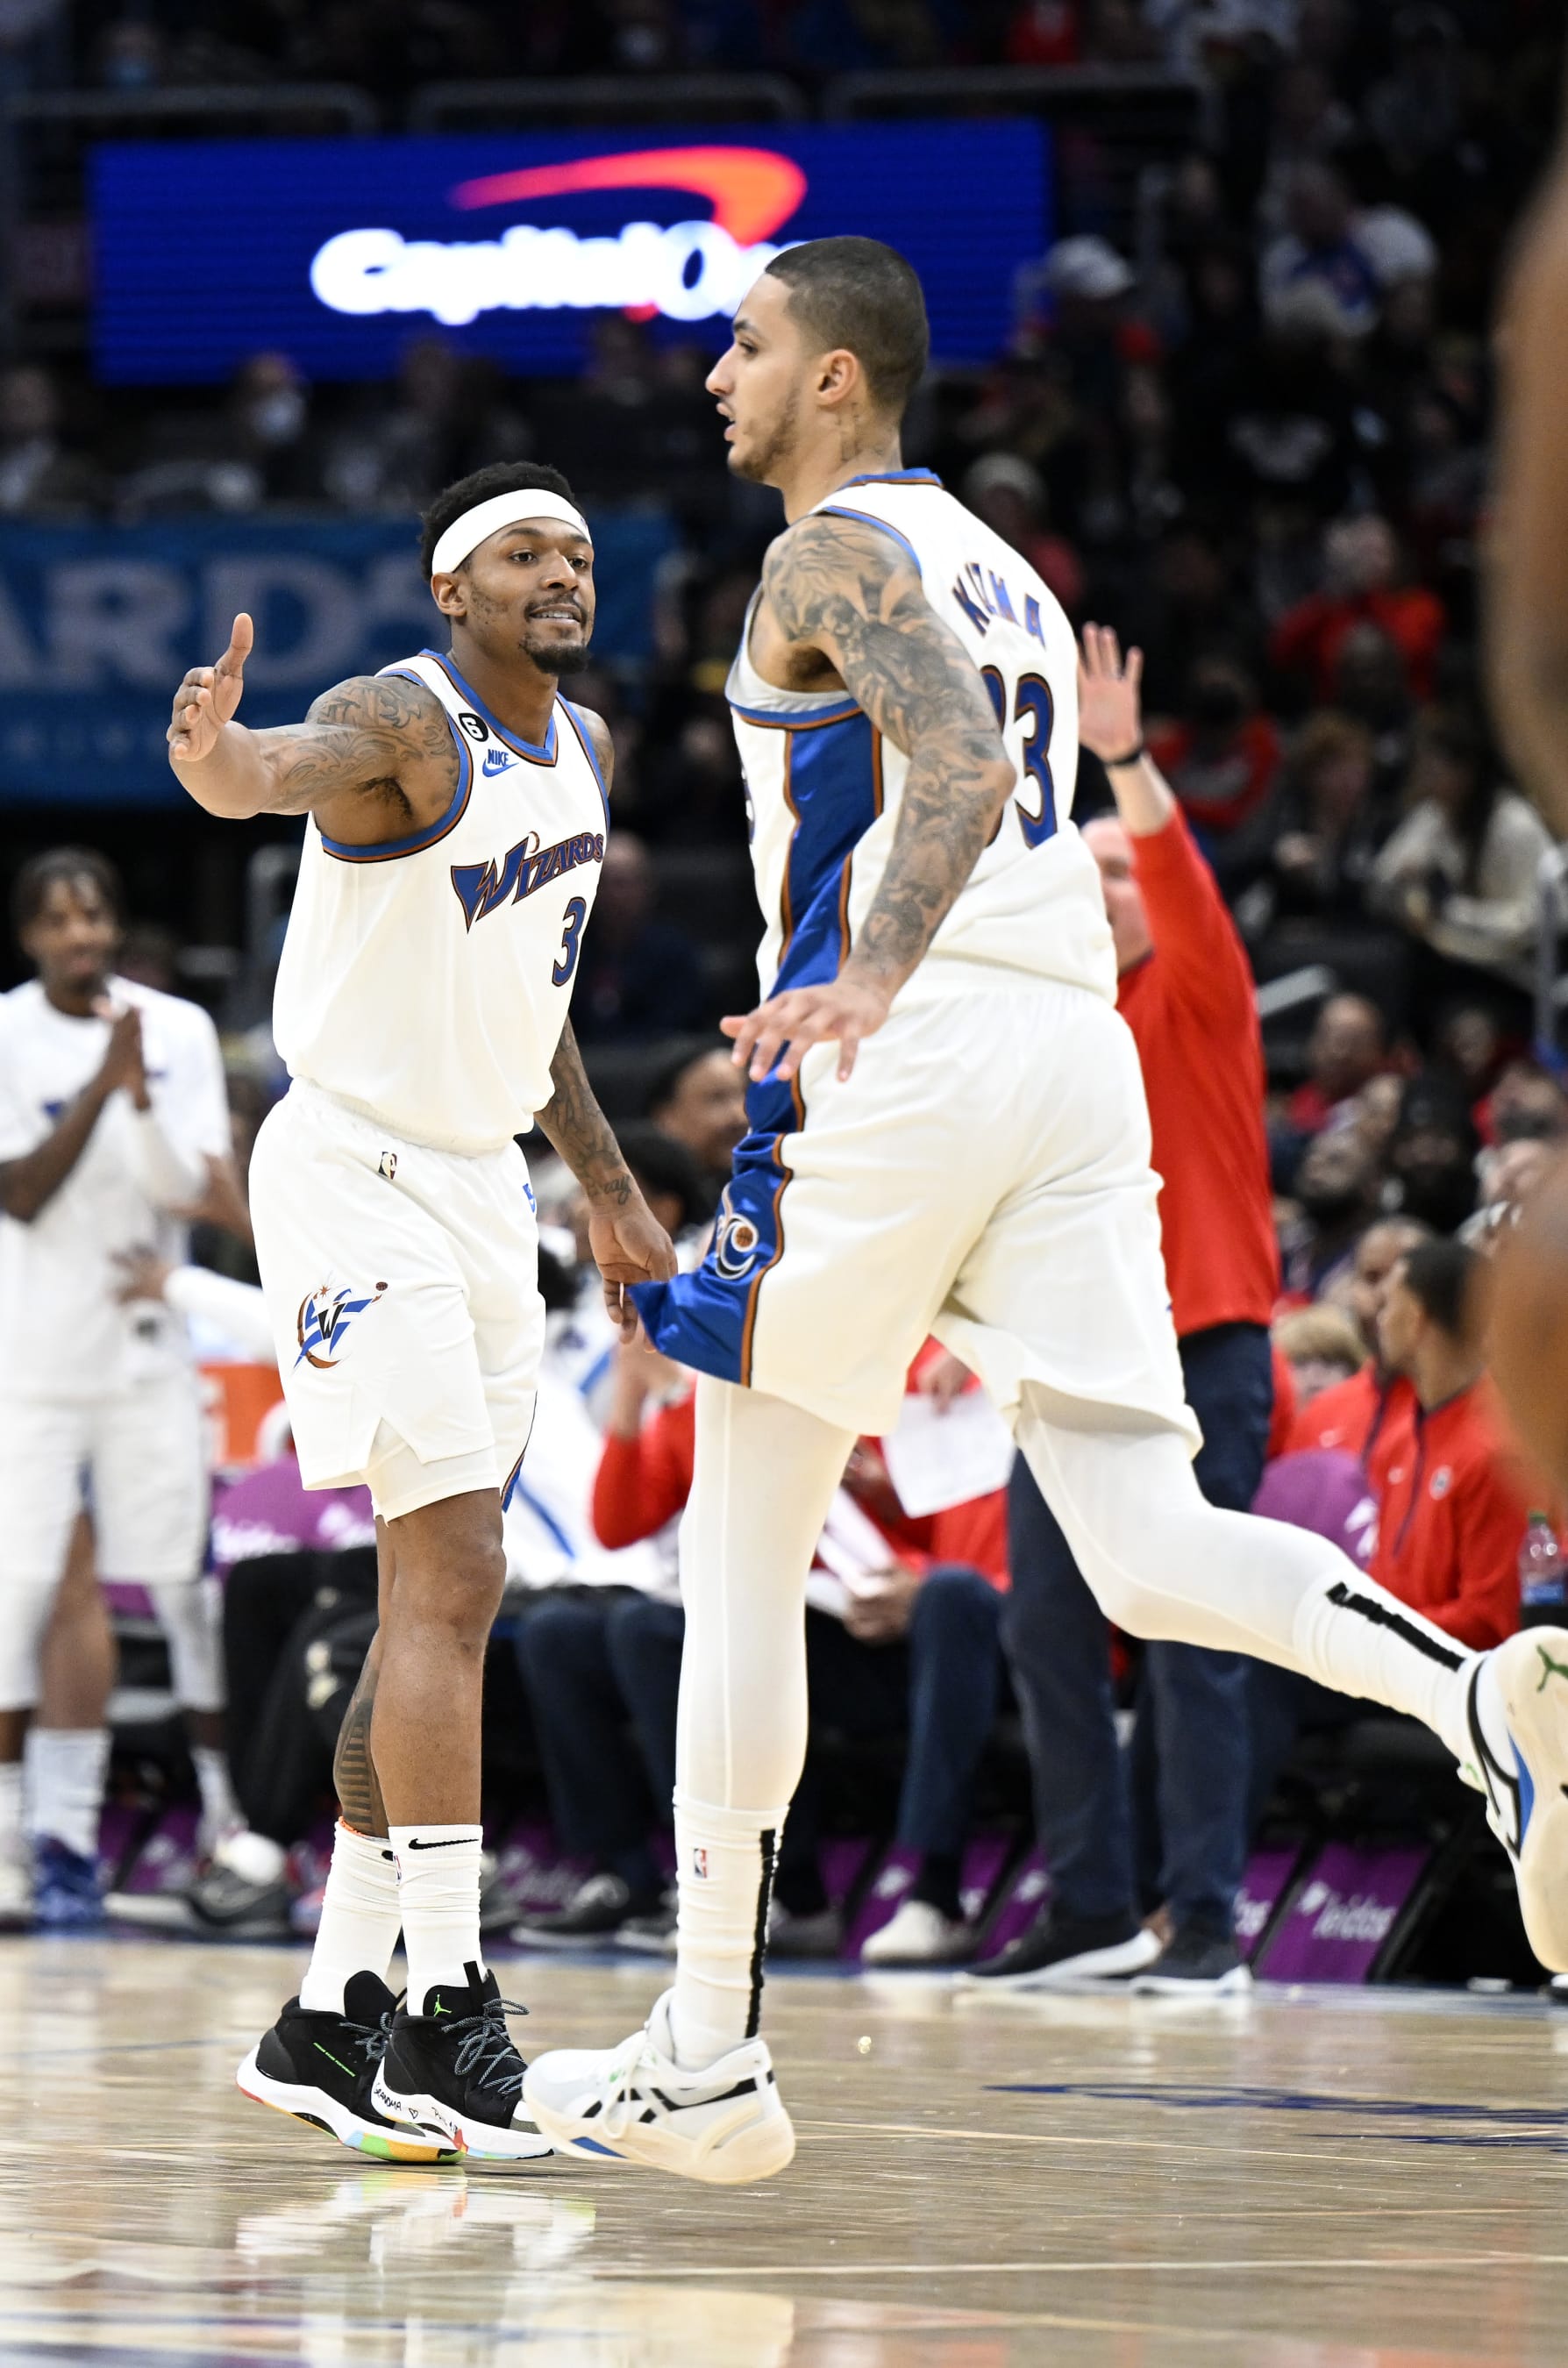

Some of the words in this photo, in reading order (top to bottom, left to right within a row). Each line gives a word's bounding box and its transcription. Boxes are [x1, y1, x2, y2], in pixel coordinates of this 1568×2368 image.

[460, 716, 485, 739] 6
[487, 748, 510, 767] NIKE
[552, 896, 587, 988] 3
